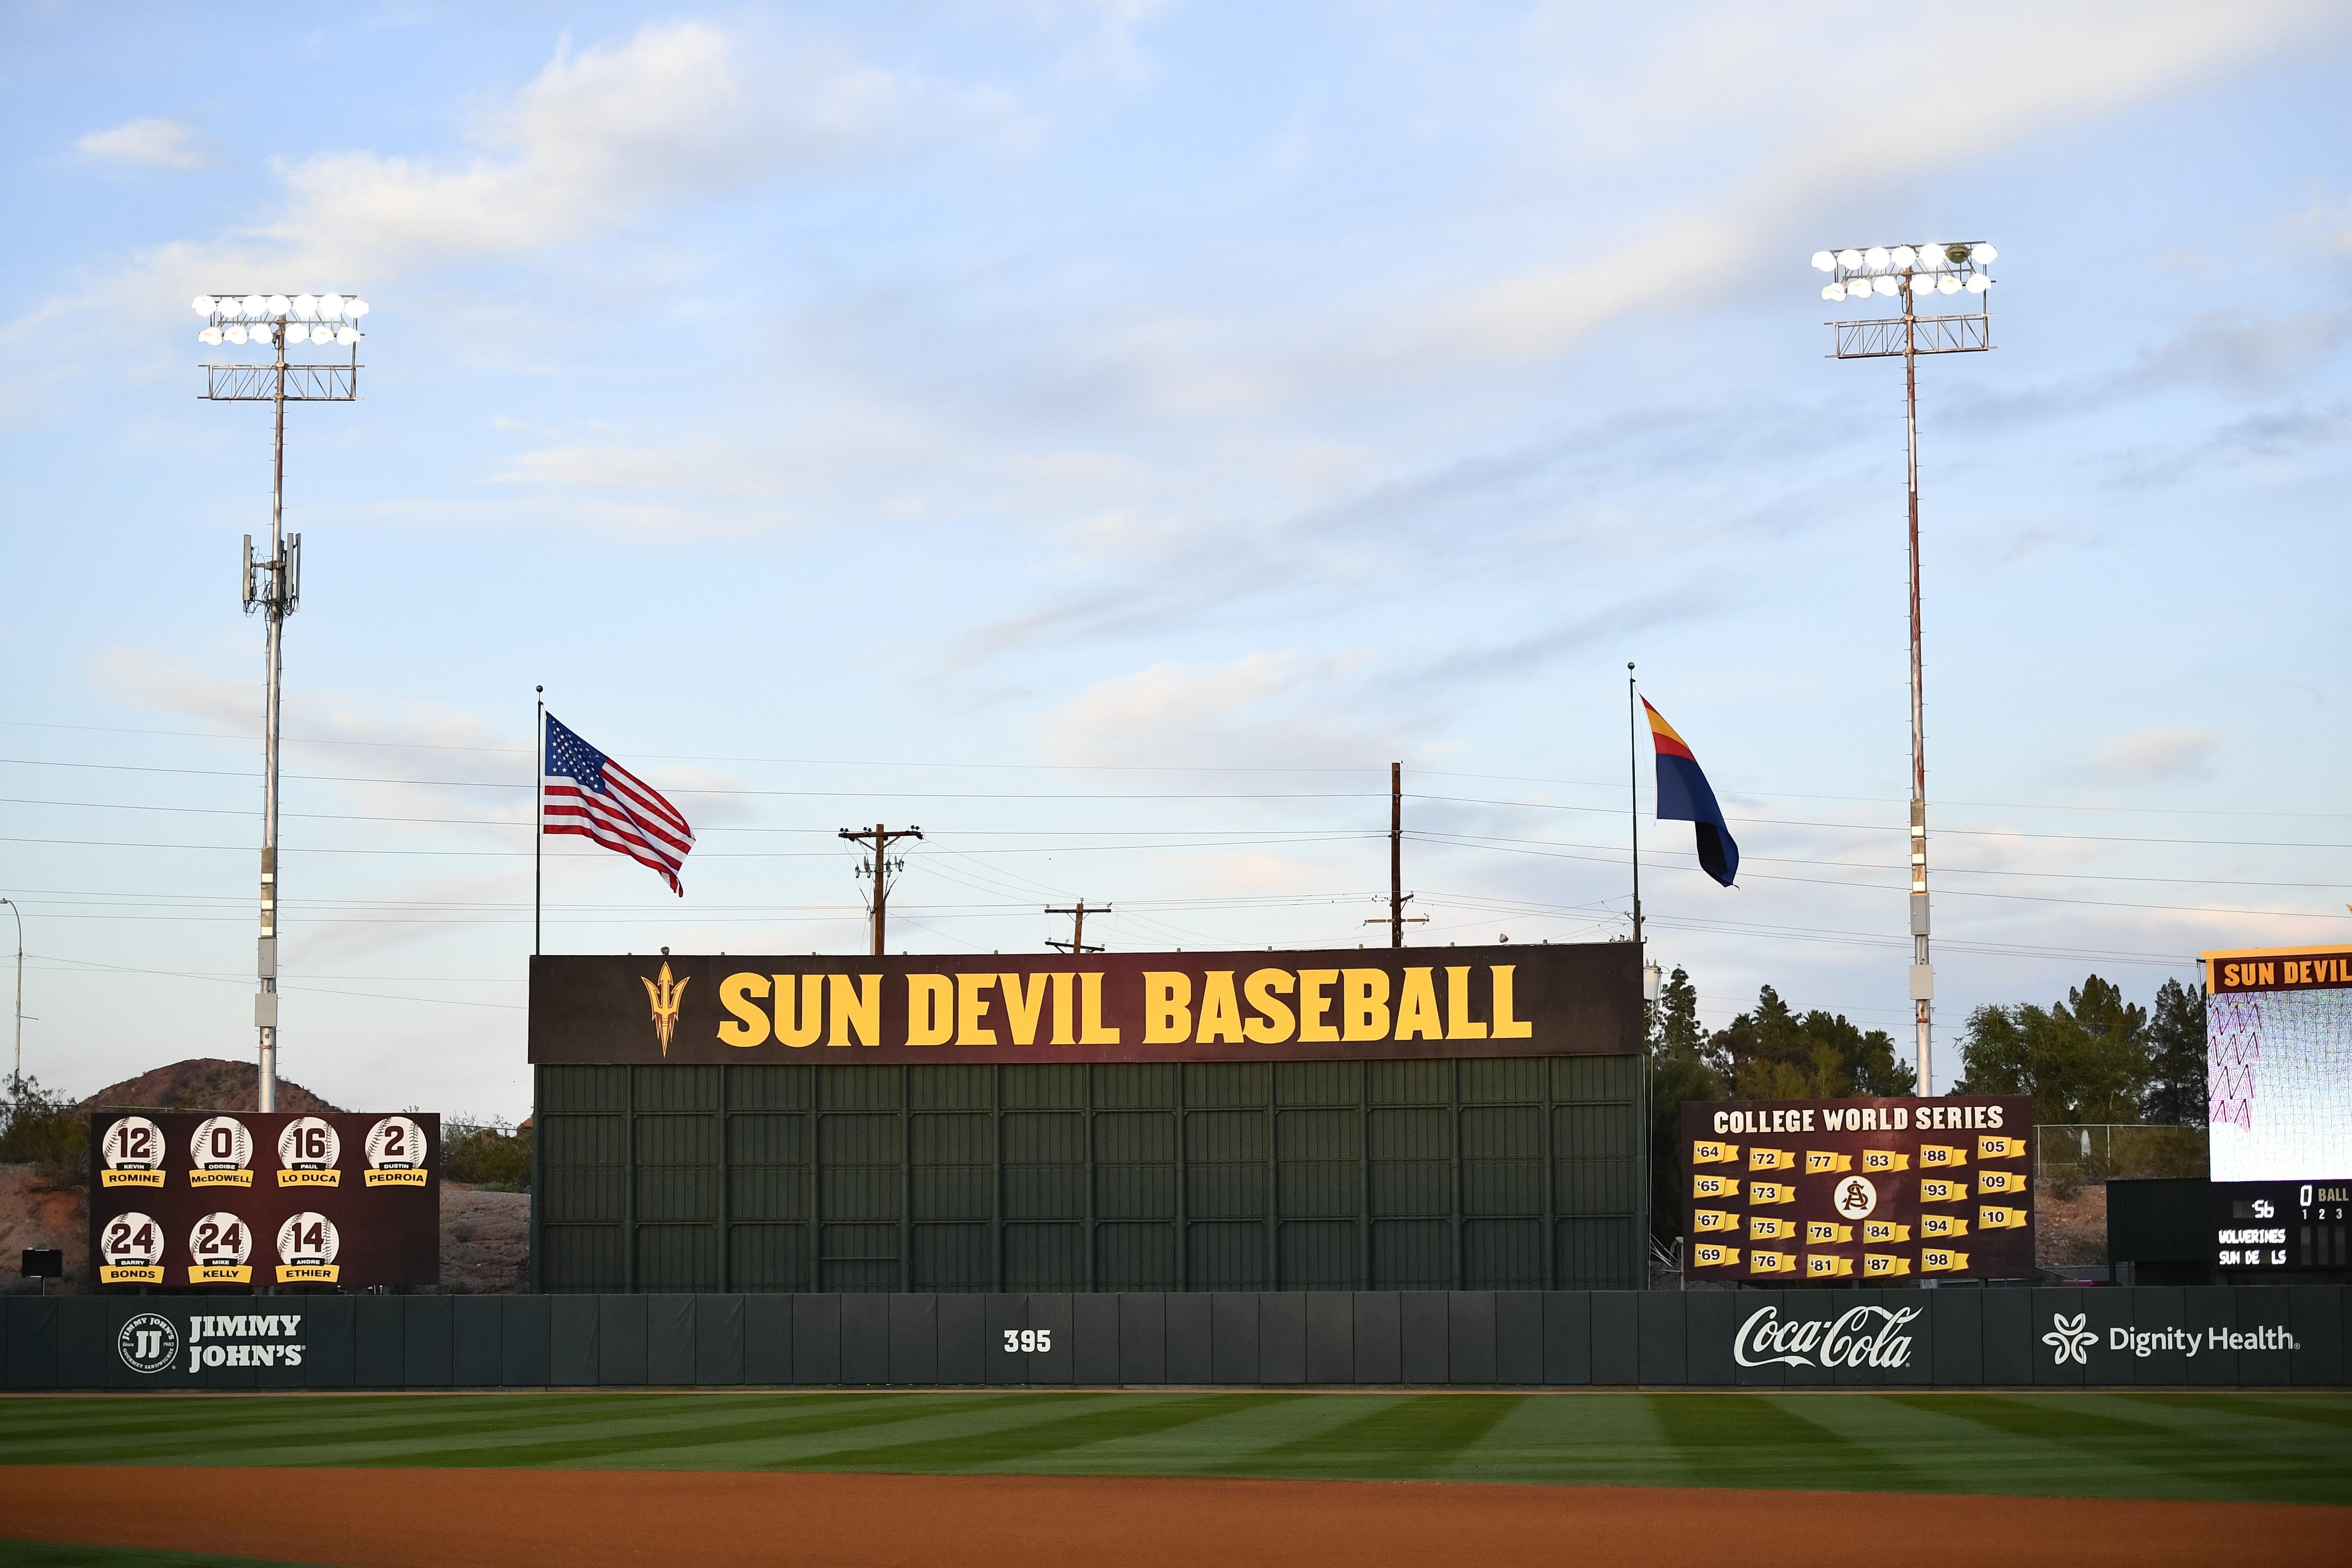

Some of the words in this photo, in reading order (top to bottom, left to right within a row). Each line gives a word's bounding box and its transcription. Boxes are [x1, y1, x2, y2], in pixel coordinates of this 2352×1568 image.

[2224, 963, 2274, 986] SUN
[2284, 960, 2352, 983] DEVIL
[716, 972, 884, 1047] SUN
[905, 972, 1119, 1045] DEVIL
[1142, 965, 1532, 1043] BASEBALL
[1714, 1110, 1814, 1133] COLLEGE
[1822, 1108, 1907, 1130] WORLD
[1916, 1106, 2003, 1129] SERIES
[117, 1127, 150, 1158] 12
[212, 1128, 232, 1158] 0
[293, 1128, 326, 1158] 16
[384, 1126, 405, 1156] 2
[191, 1175, 251, 1184] McDOWELL
[370, 1174, 423, 1182] PEDROIA
[2319, 1188, 2349, 1201] BALL
[2303, 1209, 2306, 1219] 1
[2319, 1209, 2325, 1219] 2
[2336, 1209, 2342, 1219] 3
[111, 1223, 154, 1254] 24
[199, 1223, 242, 1254] 24
[291, 1222, 325, 1253] 14
[2219, 1229, 2285, 1244] WOLVERINES
[2219, 1251, 2240, 1264] SUN
[122, 1318, 147, 1341] JIMMY
[150, 1318, 174, 1340] JOHN'S
[190, 1315, 300, 1343] JIMMY
[1004, 1330, 1050, 1352] 395
[1734, 1306, 1923, 1367] Coca-Cola
[2110, 1327, 2202, 1357] Dignity
[123, 1348, 144, 1368] GOURMET
[136, 1331, 161, 1358] JJ
